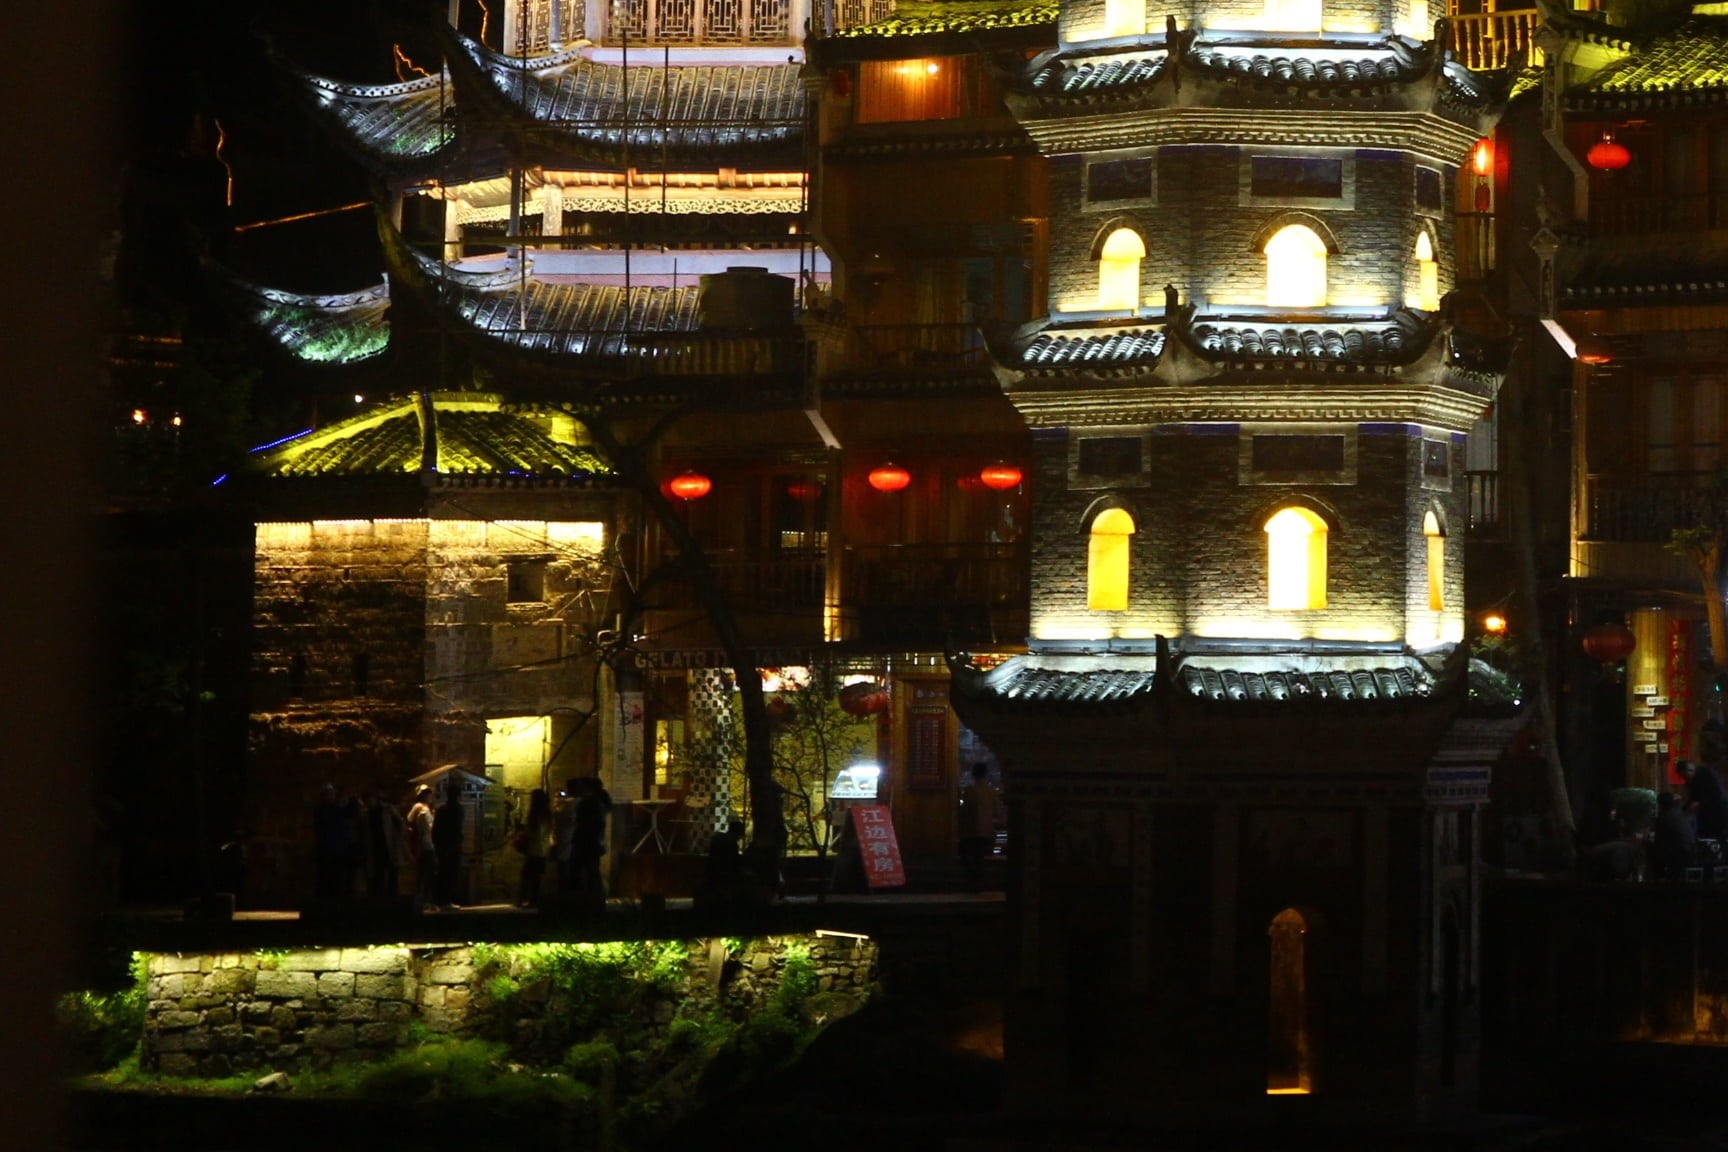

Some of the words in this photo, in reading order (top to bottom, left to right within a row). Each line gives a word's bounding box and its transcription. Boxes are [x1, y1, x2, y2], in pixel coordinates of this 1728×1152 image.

[634, 651, 707, 668] GELATO
[860, 808, 895, 873] 江边有房
